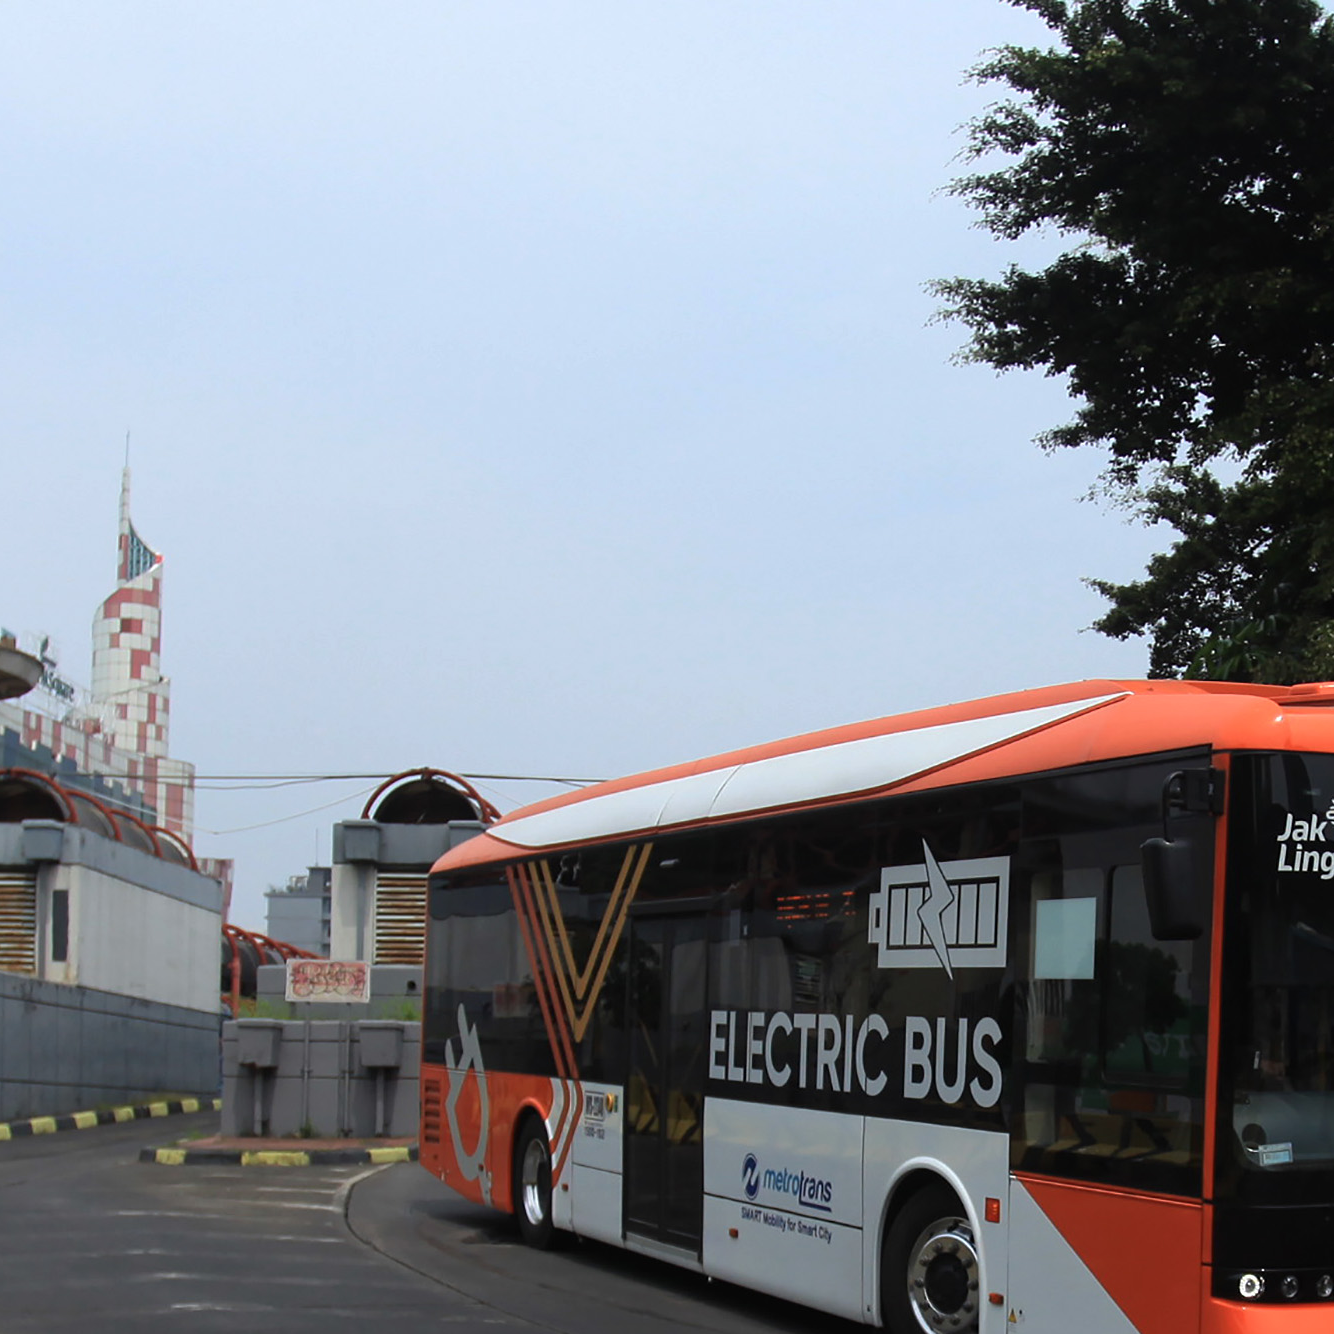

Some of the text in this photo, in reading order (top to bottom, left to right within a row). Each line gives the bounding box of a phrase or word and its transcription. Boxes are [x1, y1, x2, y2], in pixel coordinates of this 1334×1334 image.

[1277, 813, 1327, 842] Jak
[709, 1010, 1003, 1108] ELECTRIC BUS
[763, 1167, 832, 1212] metrotrans
[741, 1207, 832, 1245] SMART Mobility for Smart City
